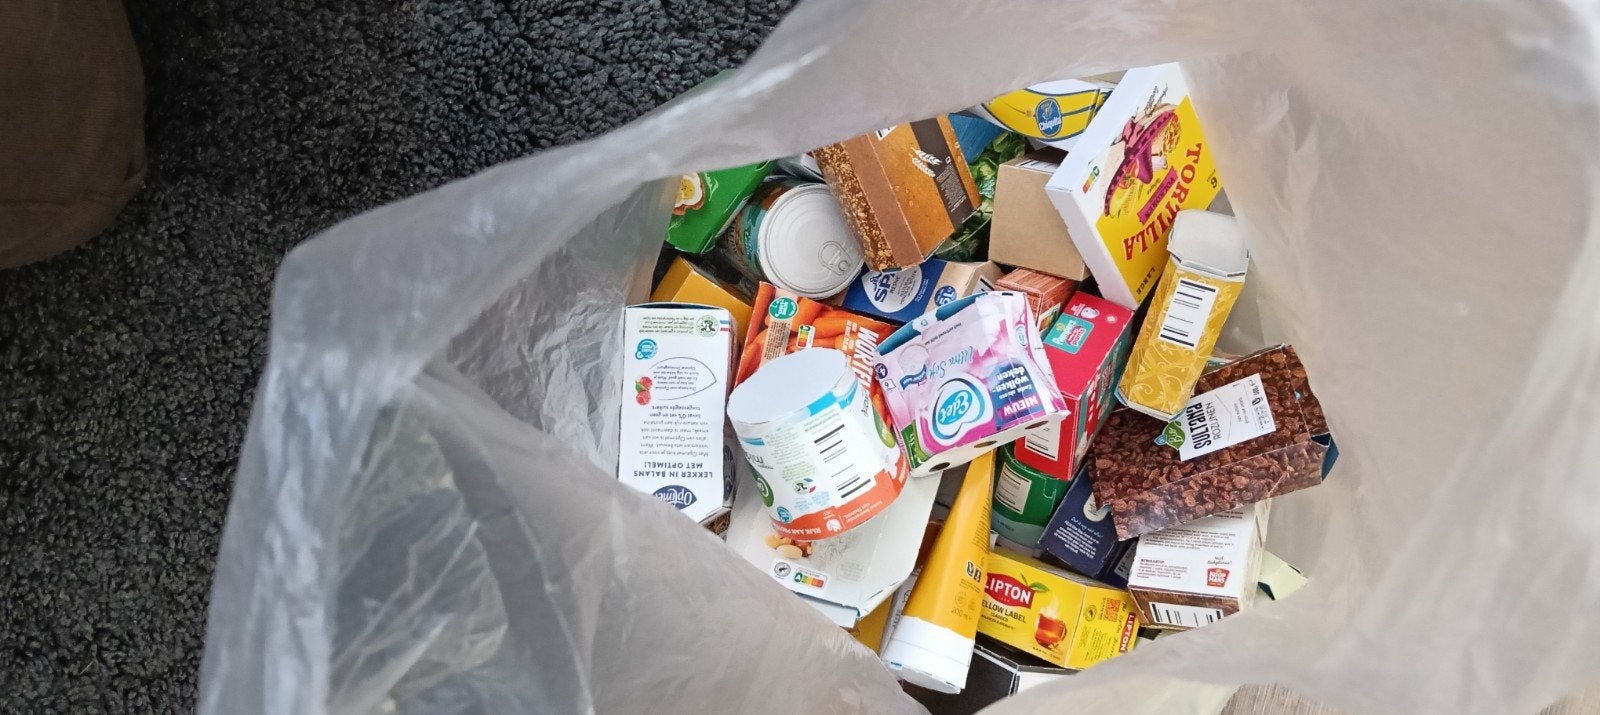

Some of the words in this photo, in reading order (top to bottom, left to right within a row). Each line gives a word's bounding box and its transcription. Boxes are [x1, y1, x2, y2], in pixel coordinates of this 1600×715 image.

[1123, 144, 1201, 260] TORTILLA
[873, 270, 895, 302] SP
[1135, 267, 1156, 294] LARGE
[1051, 318, 1076, 345] Pampers
[991, 374, 1028, 395] wolken-
[996, 365, 1025, 383] deken
[936, 390, 971, 424] Edet
[1001, 394, 1038, 414] NIEUW
[1207, 401, 1220, 439] ROZIJNEN
[981, 599, 1004, 613] ELLOW
[1004, 608, 1027, 623] LABEL
[1120, 614, 1134, 651] LIPTON
